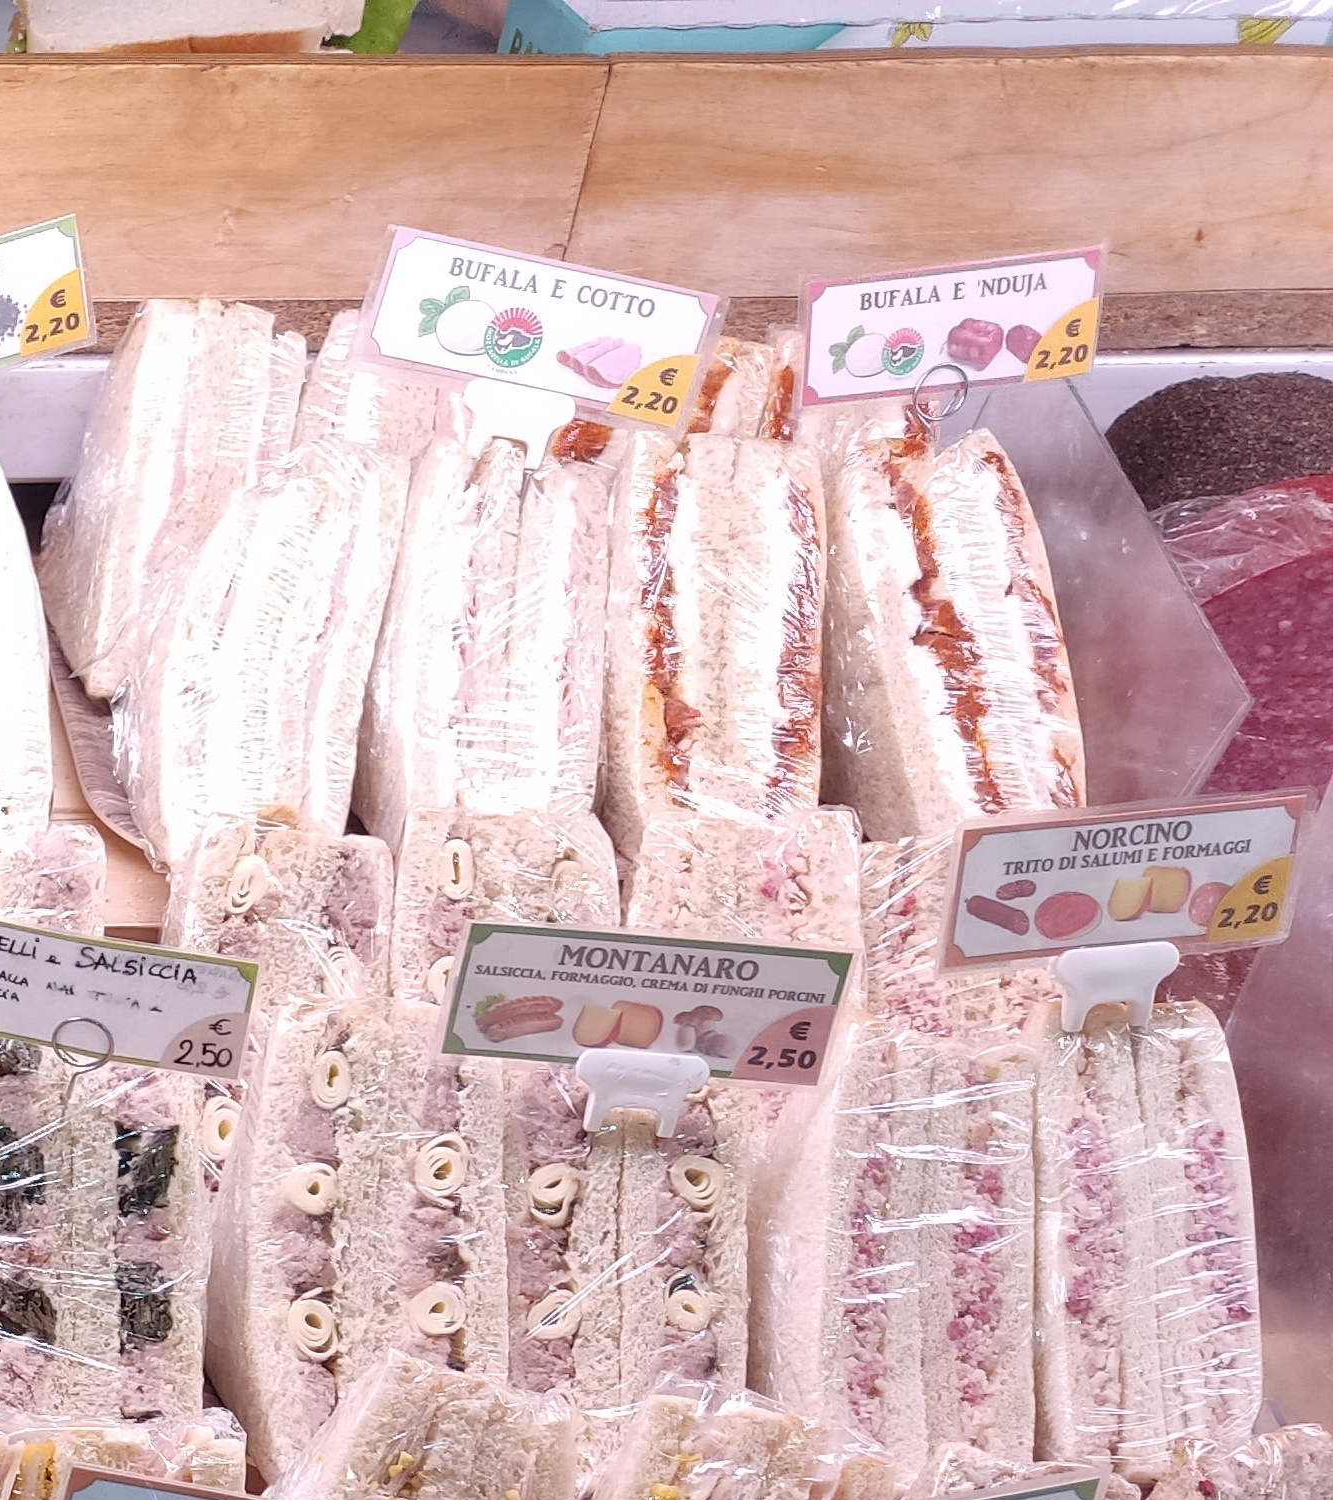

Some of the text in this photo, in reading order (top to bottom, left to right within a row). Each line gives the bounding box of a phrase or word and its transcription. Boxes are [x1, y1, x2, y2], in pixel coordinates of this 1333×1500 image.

[50, 288, 66, 308] €
[448, 256, 655, 318] BUFALA E COTTO
[859, 272, 1048, 311] BUFALA E 'NDUJA
[25, 312, 79, 344] 2,20
[1065, 318, 1082, 338] €
[1034, 344, 1089, 371] 2,20
[659, 367, 679, 387] €
[621, 385, 679, 415] 2,20
[1072, 820, 1193, 852] NORCINO
[1002, 839, 1252, 876] TRITO DI SALUMI E FORMAGGI
[1254, 874, 1273, 894] €
[1217, 901, 1278, 930] 2,20
[558, 944, 760, 982] MONTANARO
[474, 964, 826, 1004] SALSICCIA, FORMAGGIO, CREMA DI FUNGHI PORCINI
[208, 1019, 232, 1036] €
[789, 1021, 811, 1041] €
[173, 1039, 233, 1069] 2,50
[746, 1046, 817, 1070] 2,50
